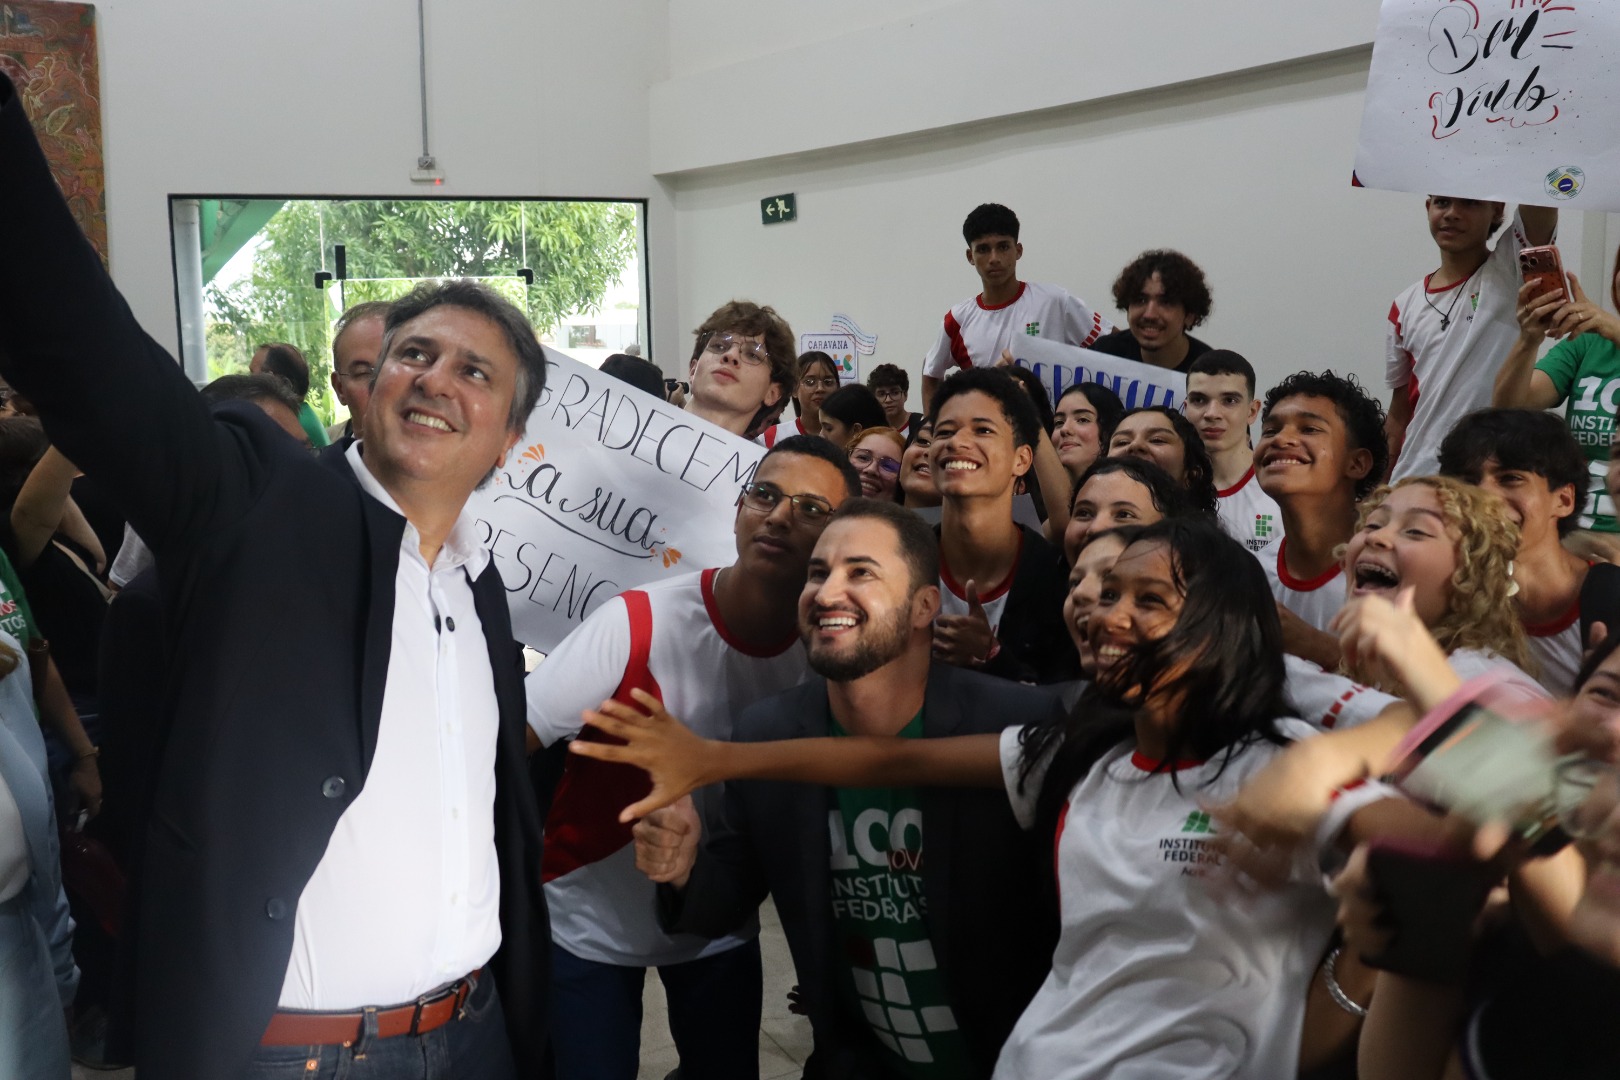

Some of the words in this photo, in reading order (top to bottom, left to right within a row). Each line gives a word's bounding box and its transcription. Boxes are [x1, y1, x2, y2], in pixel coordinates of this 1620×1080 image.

[1433, 65, 1560, 129] Vindo
[808, 340, 849, 350] CARAVANA
[1571, 415, 1619, 431] INSTI
[504, 463, 563, 505] a
[559, 487, 666, 551] sua
